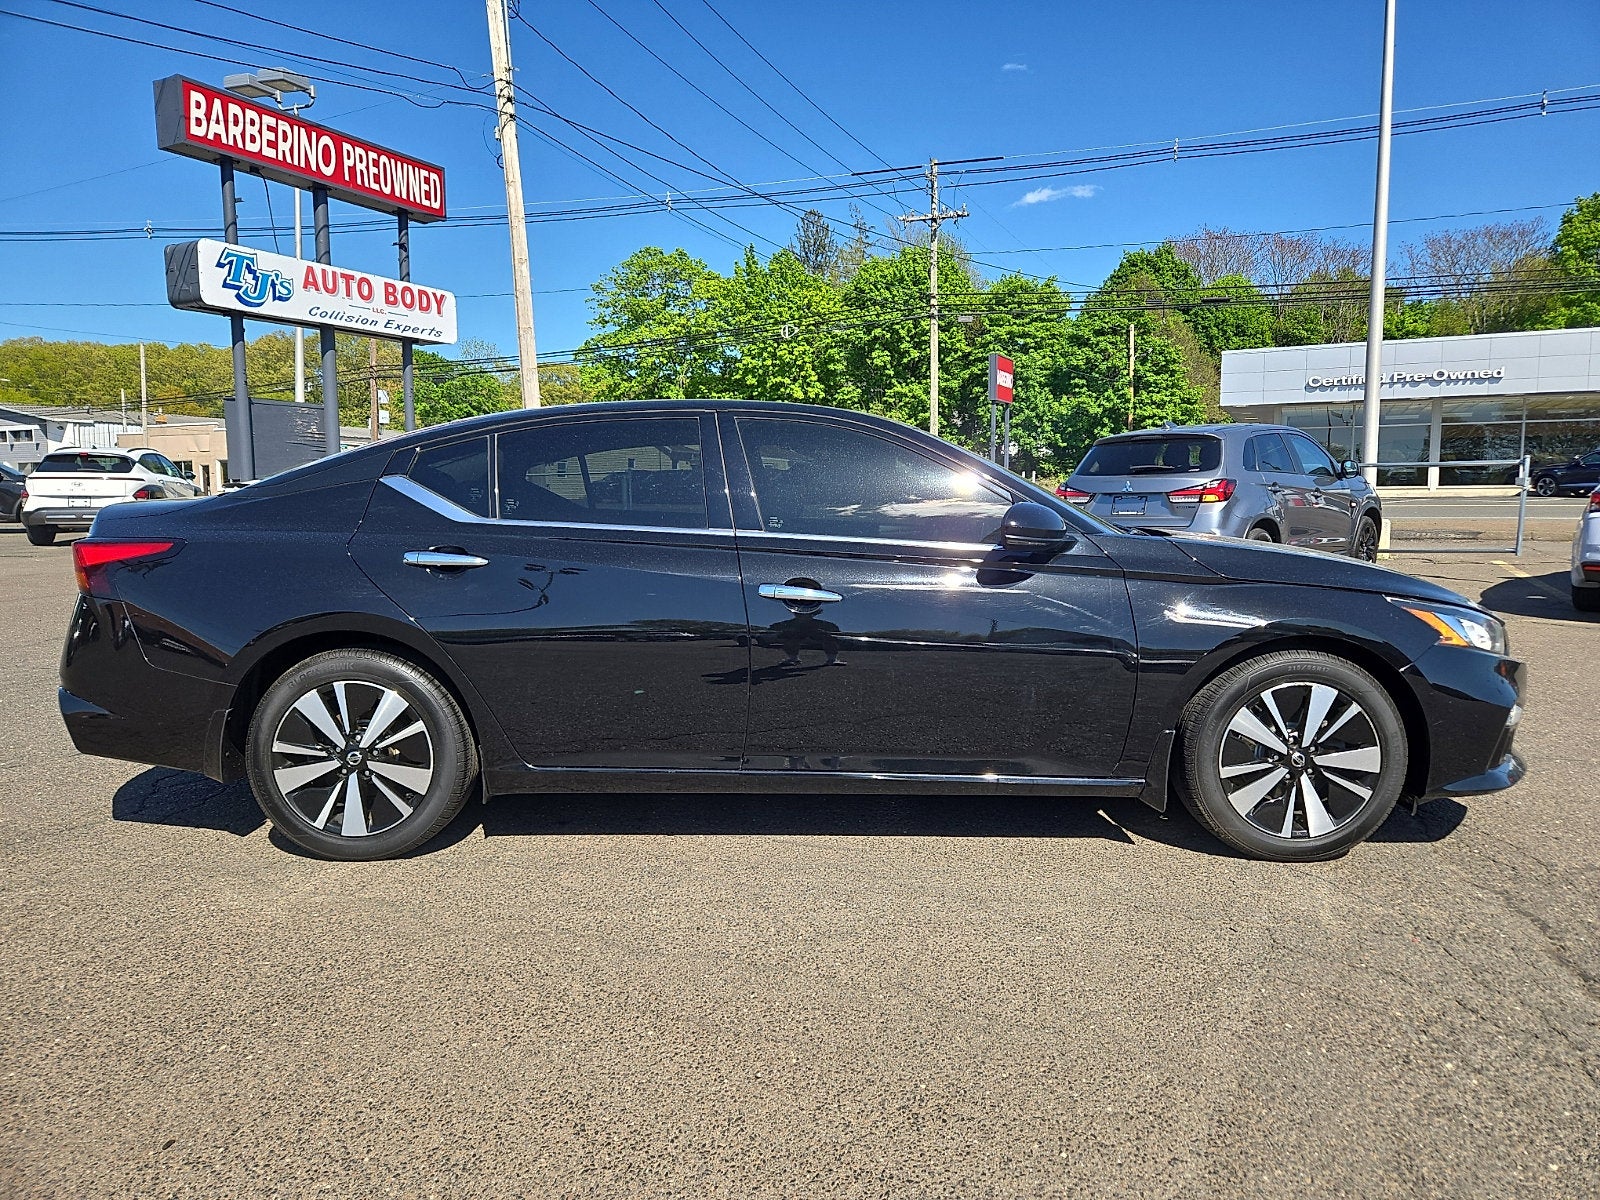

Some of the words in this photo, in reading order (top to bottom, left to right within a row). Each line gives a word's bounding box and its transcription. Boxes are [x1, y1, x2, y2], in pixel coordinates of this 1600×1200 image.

[189, 89, 336, 177] BARBERINO
[342, 141, 441, 210] PREOWNED
[215, 247, 295, 308] TJ's
[302, 265, 374, 303] AUTO
[384, 281, 446, 317] BODY
[308, 306, 379, 327] Collision
[384, 319, 443, 338] Experts
[1308, 373, 1387, 387] Certifid
[1393, 366, 1506, 383] Pre-Owned
